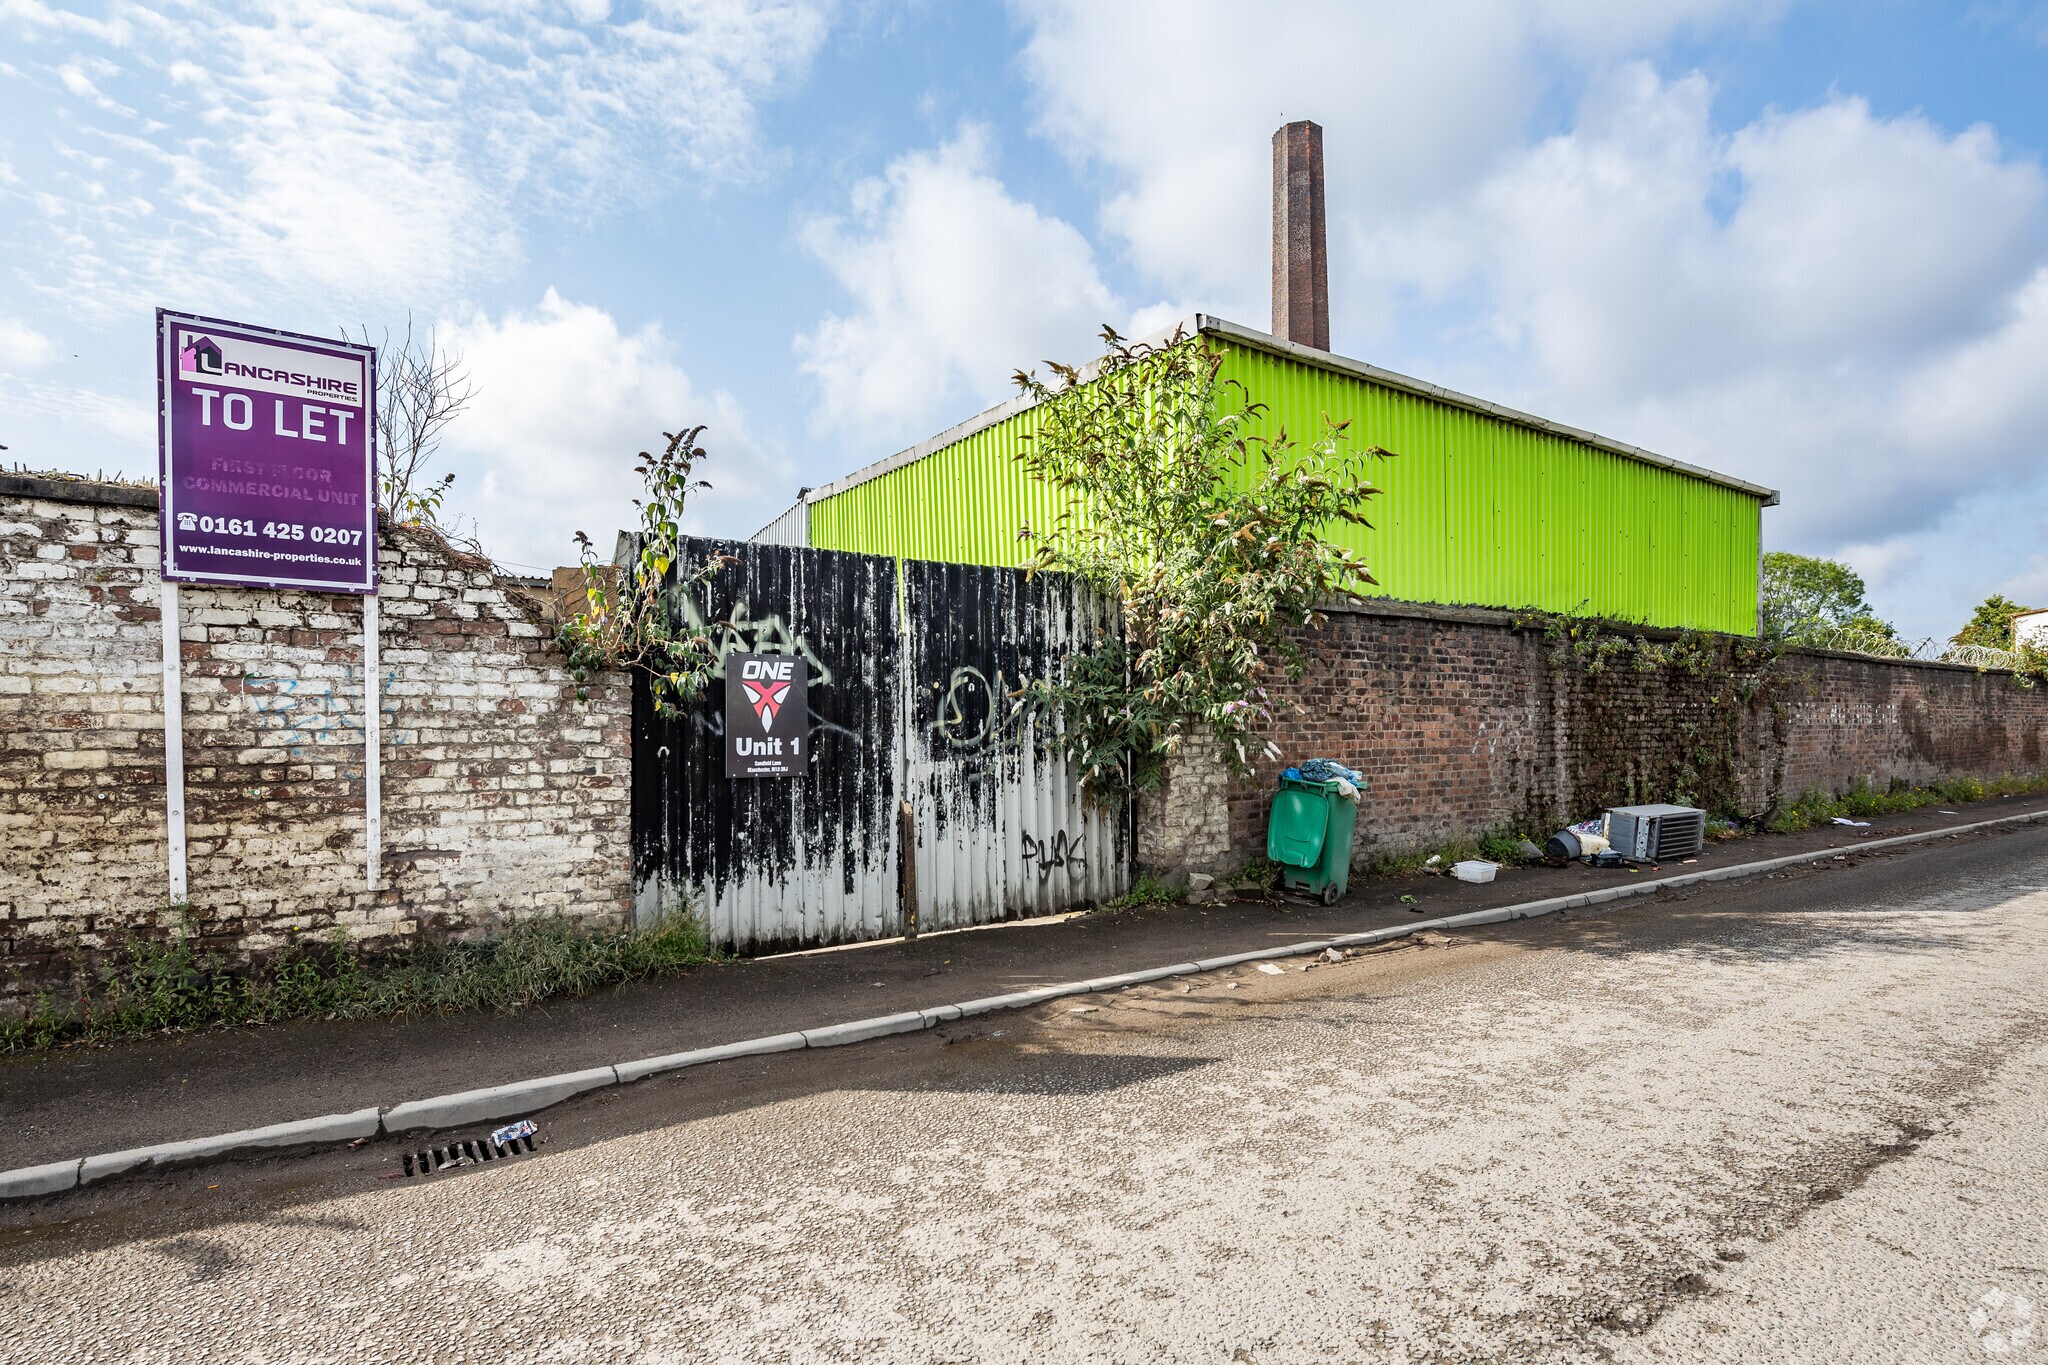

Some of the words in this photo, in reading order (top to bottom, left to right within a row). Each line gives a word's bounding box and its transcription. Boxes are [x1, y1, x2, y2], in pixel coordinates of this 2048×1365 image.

[201, 353, 358, 395] LANCASHIRE
[306, 389, 358, 402] PROPERTIES
[192, 387, 253, 431] TO
[275, 399, 355, 445] LET
[211, 457, 266, 476] FIRST
[182, 475, 314, 502] COMMERCIAL
[318, 488, 359, 506] UNIT
[199, 515, 258, 537] 0161
[262, 521, 305, 541] 425
[310, 526, 363, 546] 0207
[178, 544, 362, 567] www.lancashire-properties.co.uk
[742, 660, 795, 681] ONE
[735, 736, 783, 756] Unit
[790, 737, 800, 755] 1
